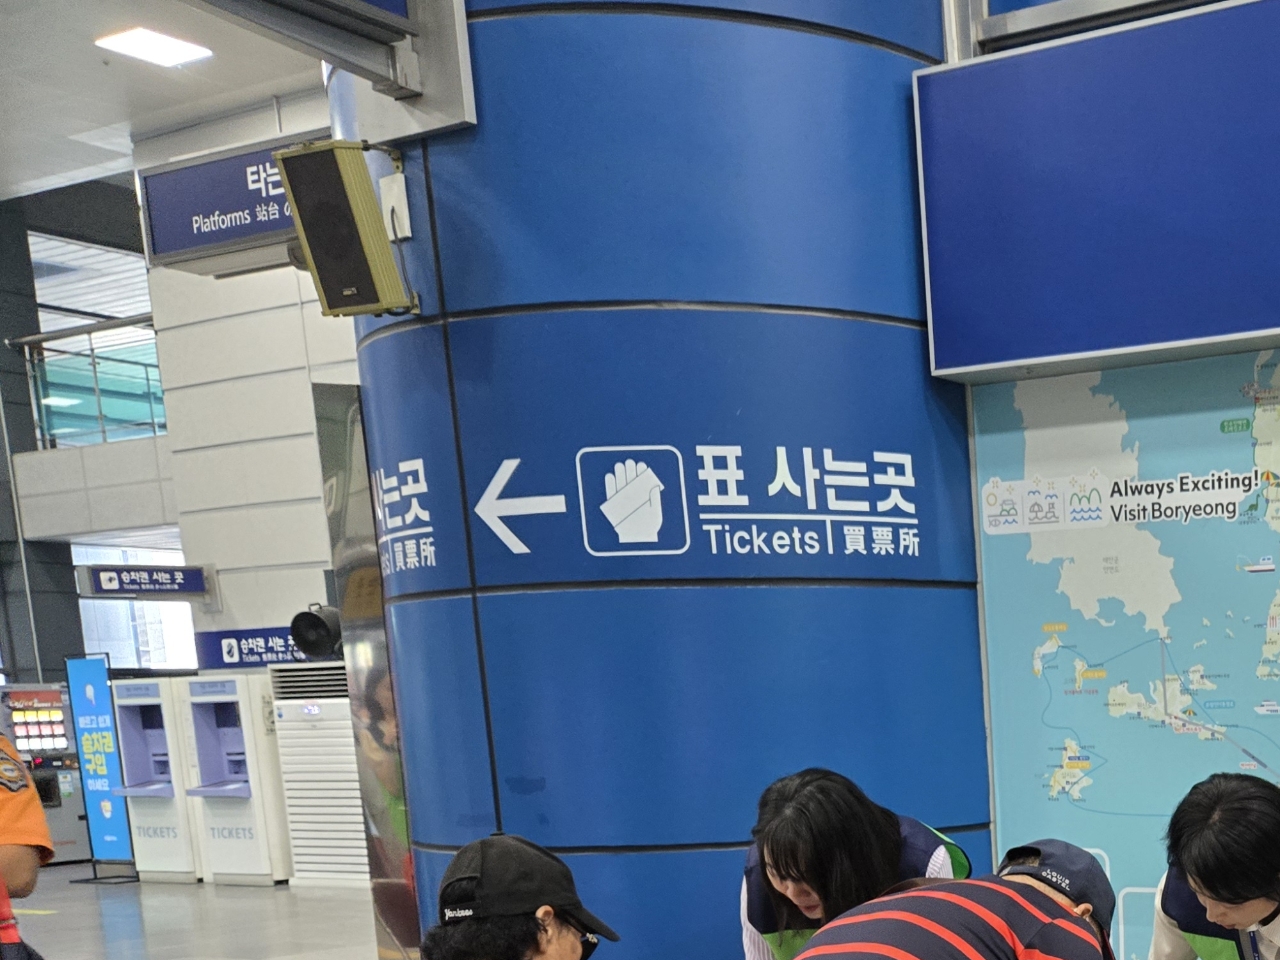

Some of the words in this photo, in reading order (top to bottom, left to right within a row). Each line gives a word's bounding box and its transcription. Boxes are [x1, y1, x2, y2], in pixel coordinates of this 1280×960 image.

[192, 209, 251, 234] Platforms
[696, 445, 749, 506] 표
[767, 446, 916, 514] 사는곳
[1110, 479, 1175, 499] Always
[1178, 469, 1260, 493] Exciting!
[1110, 504, 1148, 523] Visit
[1151, 500, 1237, 523] Boryeong
[702, 524, 820, 555] Tickets
[843, 525, 920, 557] 買票所
[240, 637, 266, 654] 승차권
[81, 731, 114, 753] 승차권
[84, 753, 107, 775] 구입
[136, 826, 177, 839] TICKETS
[210, 827, 254, 840] TICKETS
